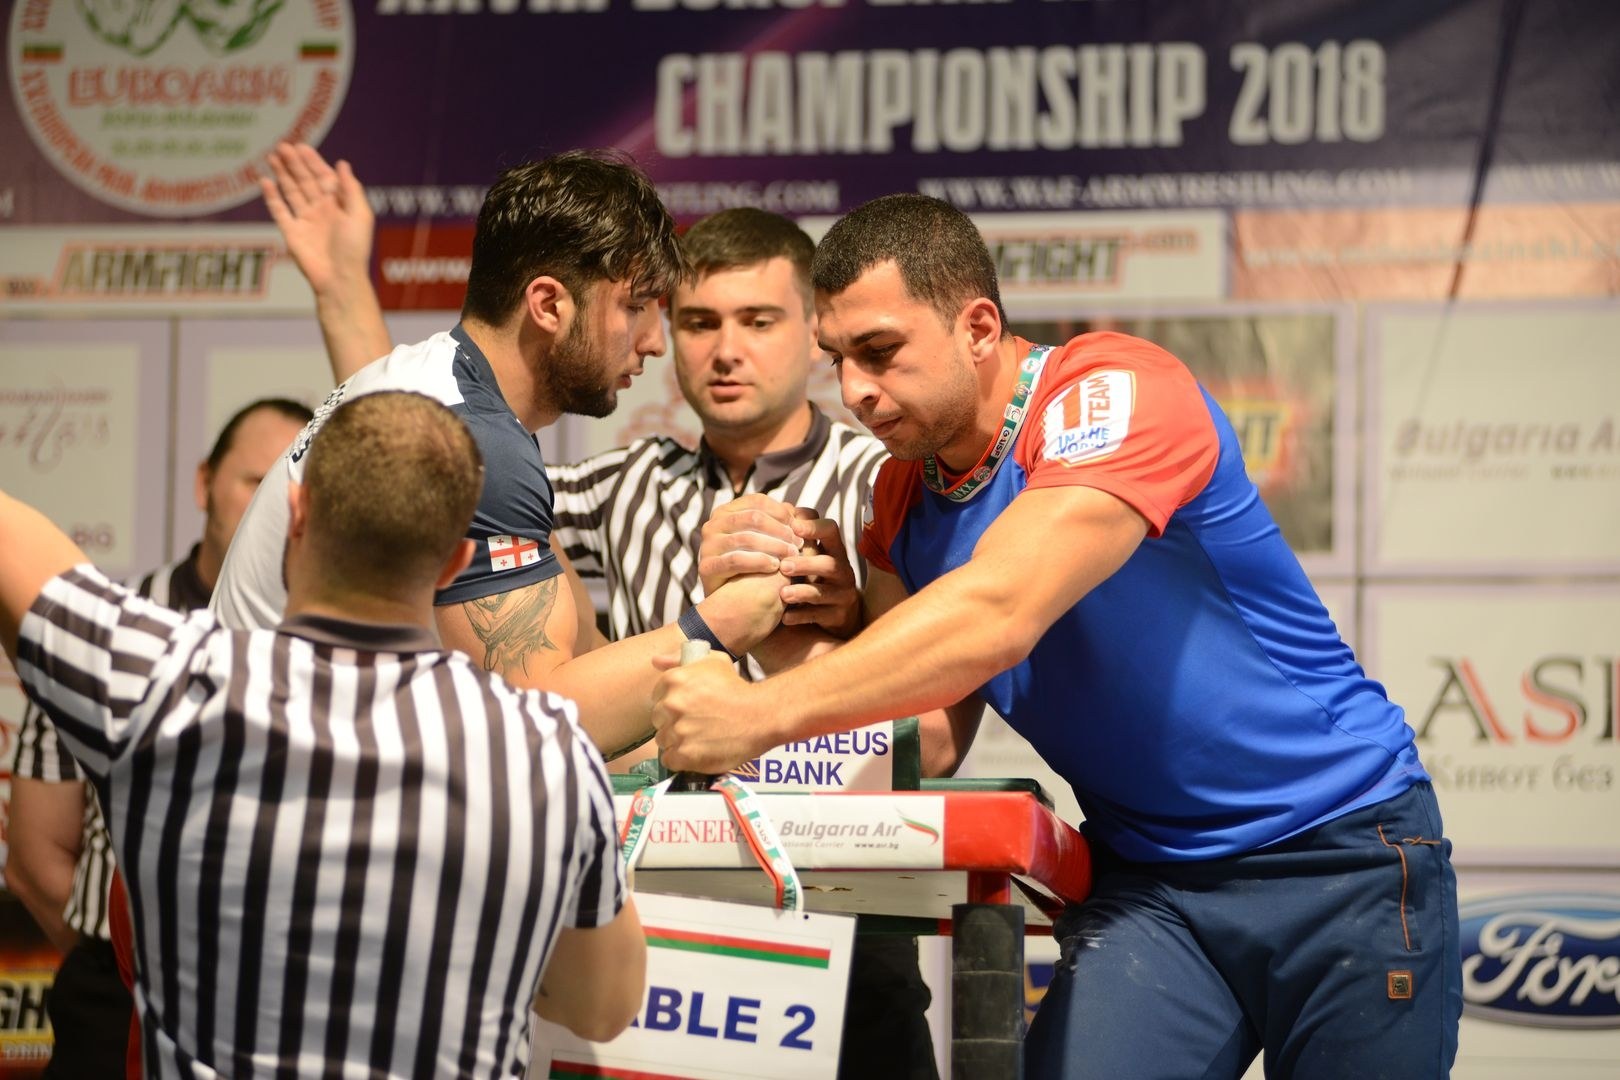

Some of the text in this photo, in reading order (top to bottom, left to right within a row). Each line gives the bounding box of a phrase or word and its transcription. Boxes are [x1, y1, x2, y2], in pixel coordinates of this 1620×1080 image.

[655, 40, 1387, 157] CHAMPIONSHIP 2018
[62, 246, 268, 289] ARMFIGHT
[1087, 375, 1111, 427] TEAM
[1586, 415, 1620, 454] A
[765, 759, 844, 786] BANK
[1552, 753, 1614, 793] без
[782, 841, 813, 849] ational
[872, 822, 903, 838] Air
[1462, 911, 1620, 1006] For
[629, 985, 815, 1050] BLE 2
